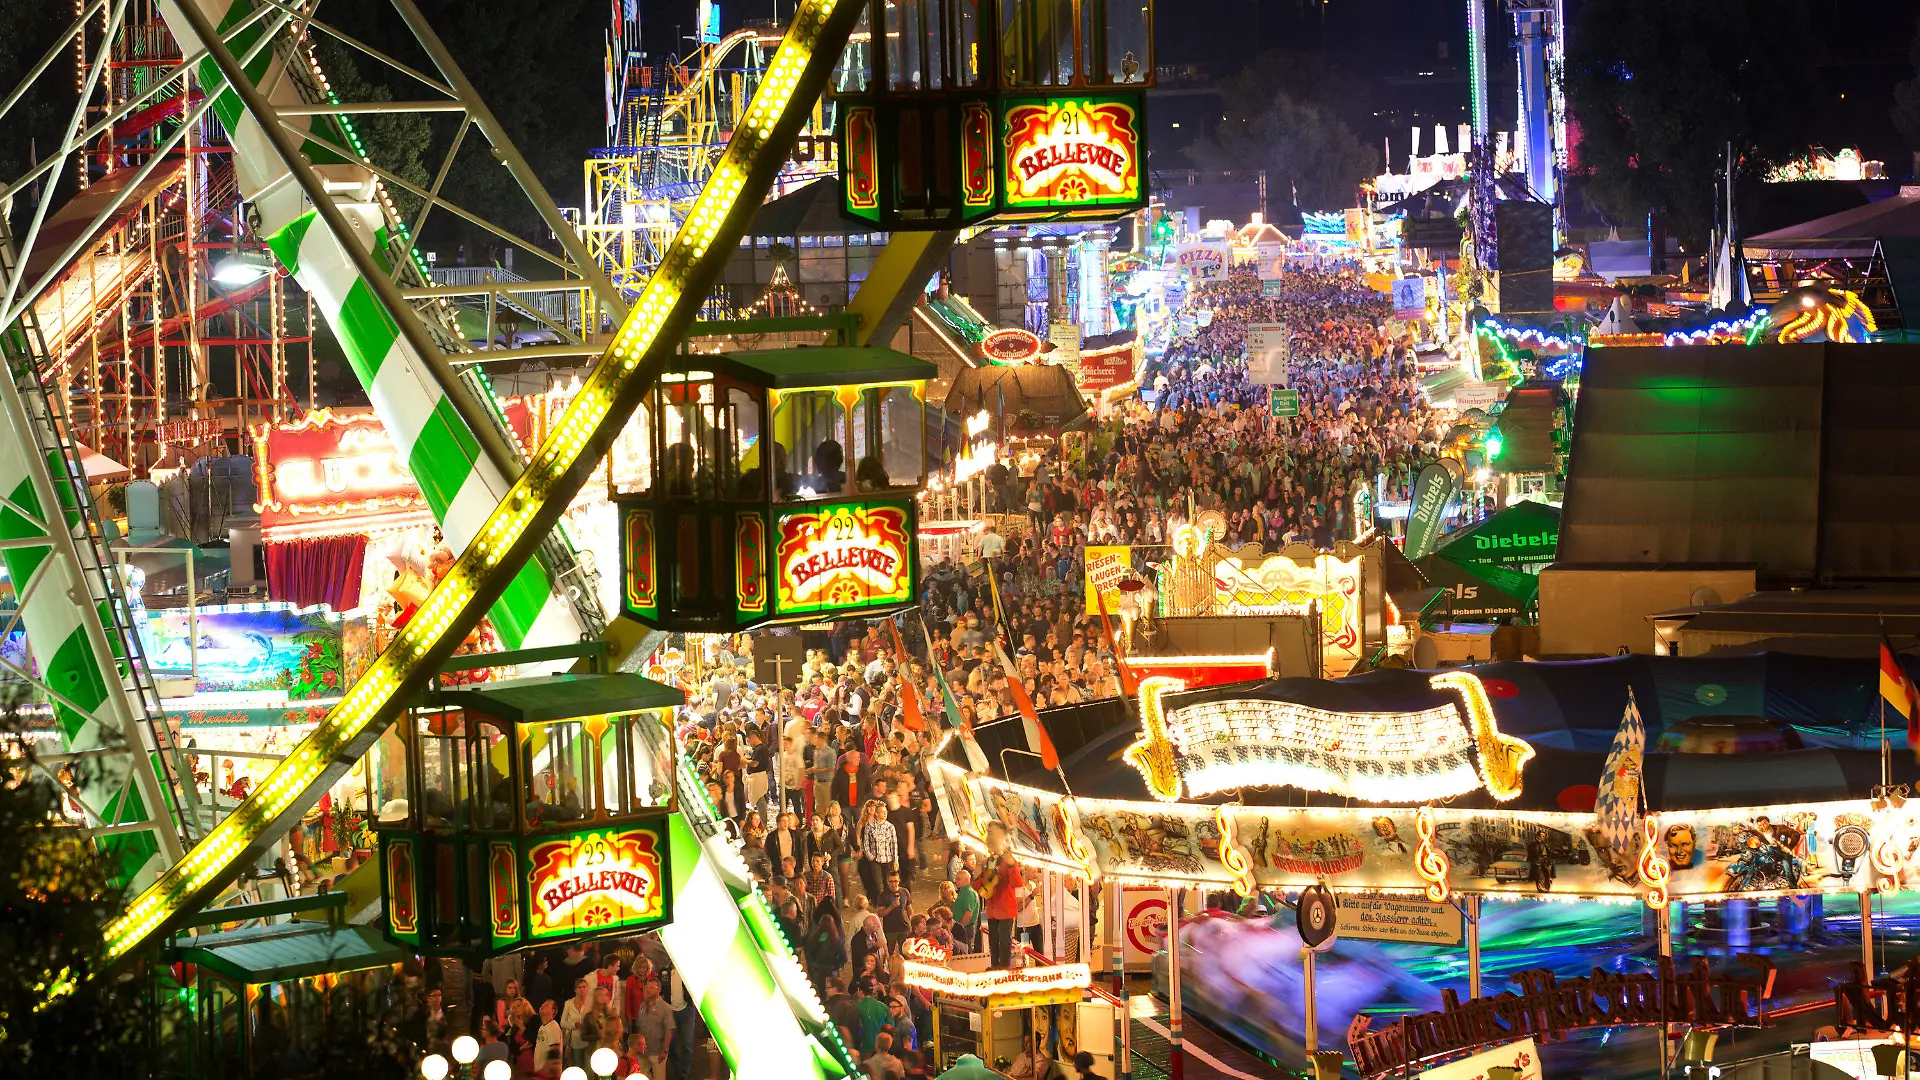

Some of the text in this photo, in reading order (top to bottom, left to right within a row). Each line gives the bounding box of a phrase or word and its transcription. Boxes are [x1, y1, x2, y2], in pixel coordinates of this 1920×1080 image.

[1062, 111, 1080, 135] 21
[1019, 142, 1125, 180] BELLEVUE
[1179, 249, 1223, 265] PIZZA
[1413, 473, 1444, 523] Diebels
[833, 516, 855, 540] 22
[1472, 532, 1559, 549] Diebels
[791, 547, 896, 587] BELLEVUE
[1086, 554, 1121, 572] RIESEN-
[1090, 564, 1126, 583] LAUGEN-
[187, 711, 249, 724] Mandeln
[584, 841, 606, 866] 23
[543, 870, 648, 911] BELLEVUE
[1343, 899, 1359, 908] Bitte
[1360, 901, 1373, 911] auf
[1373, 901, 1381, 909] die
[1431, 906, 1444, 914] und
[1375, 913, 1408, 923] Kassierer
[910, 938, 945, 961] Kasse
